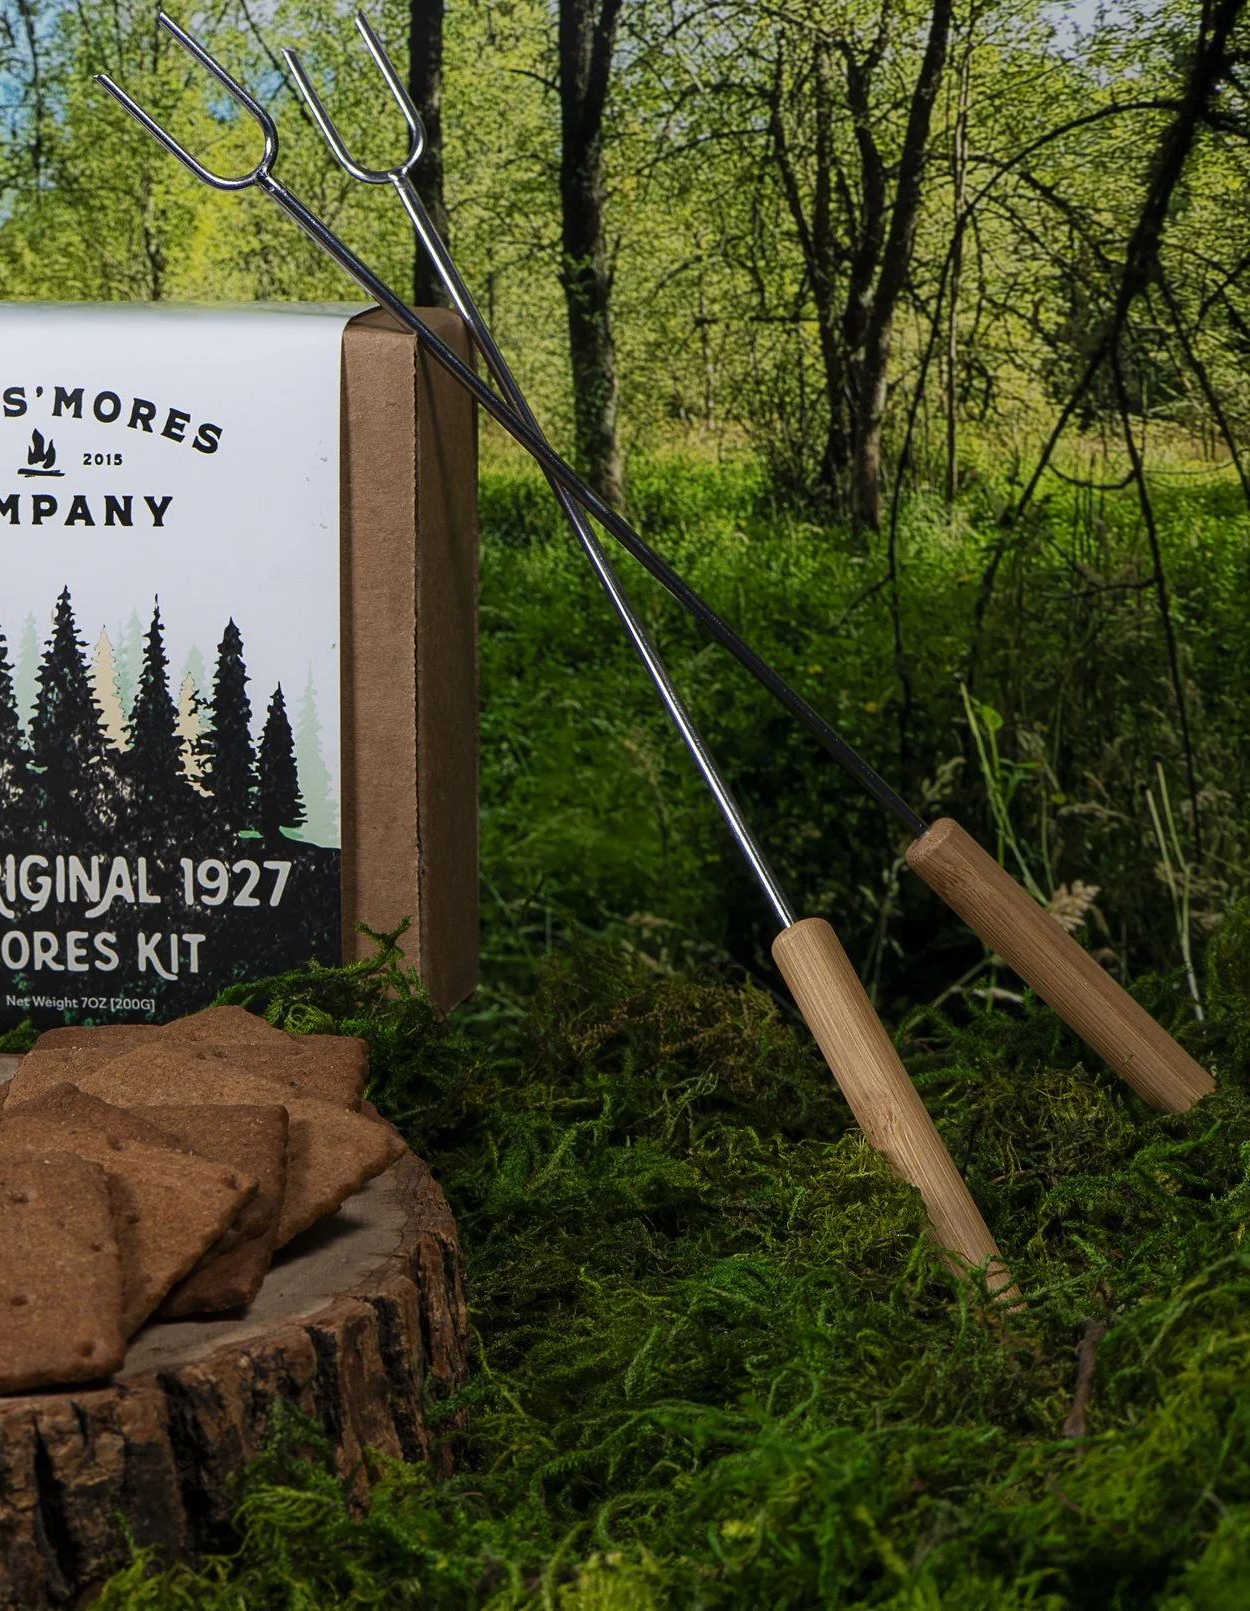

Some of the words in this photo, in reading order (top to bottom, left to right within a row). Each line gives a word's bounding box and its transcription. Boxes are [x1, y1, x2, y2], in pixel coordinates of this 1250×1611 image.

[2, 385, 223, 454] S'MORES
[82, 453, 123, 466] 2015
[180, 858, 292, 907] 1927
[138, 932, 206, 980] KIT
[5, 995, 31, 1007] Net
[32, 996, 79, 1010] Weight
[110, 998, 155, 1013] [200G]
